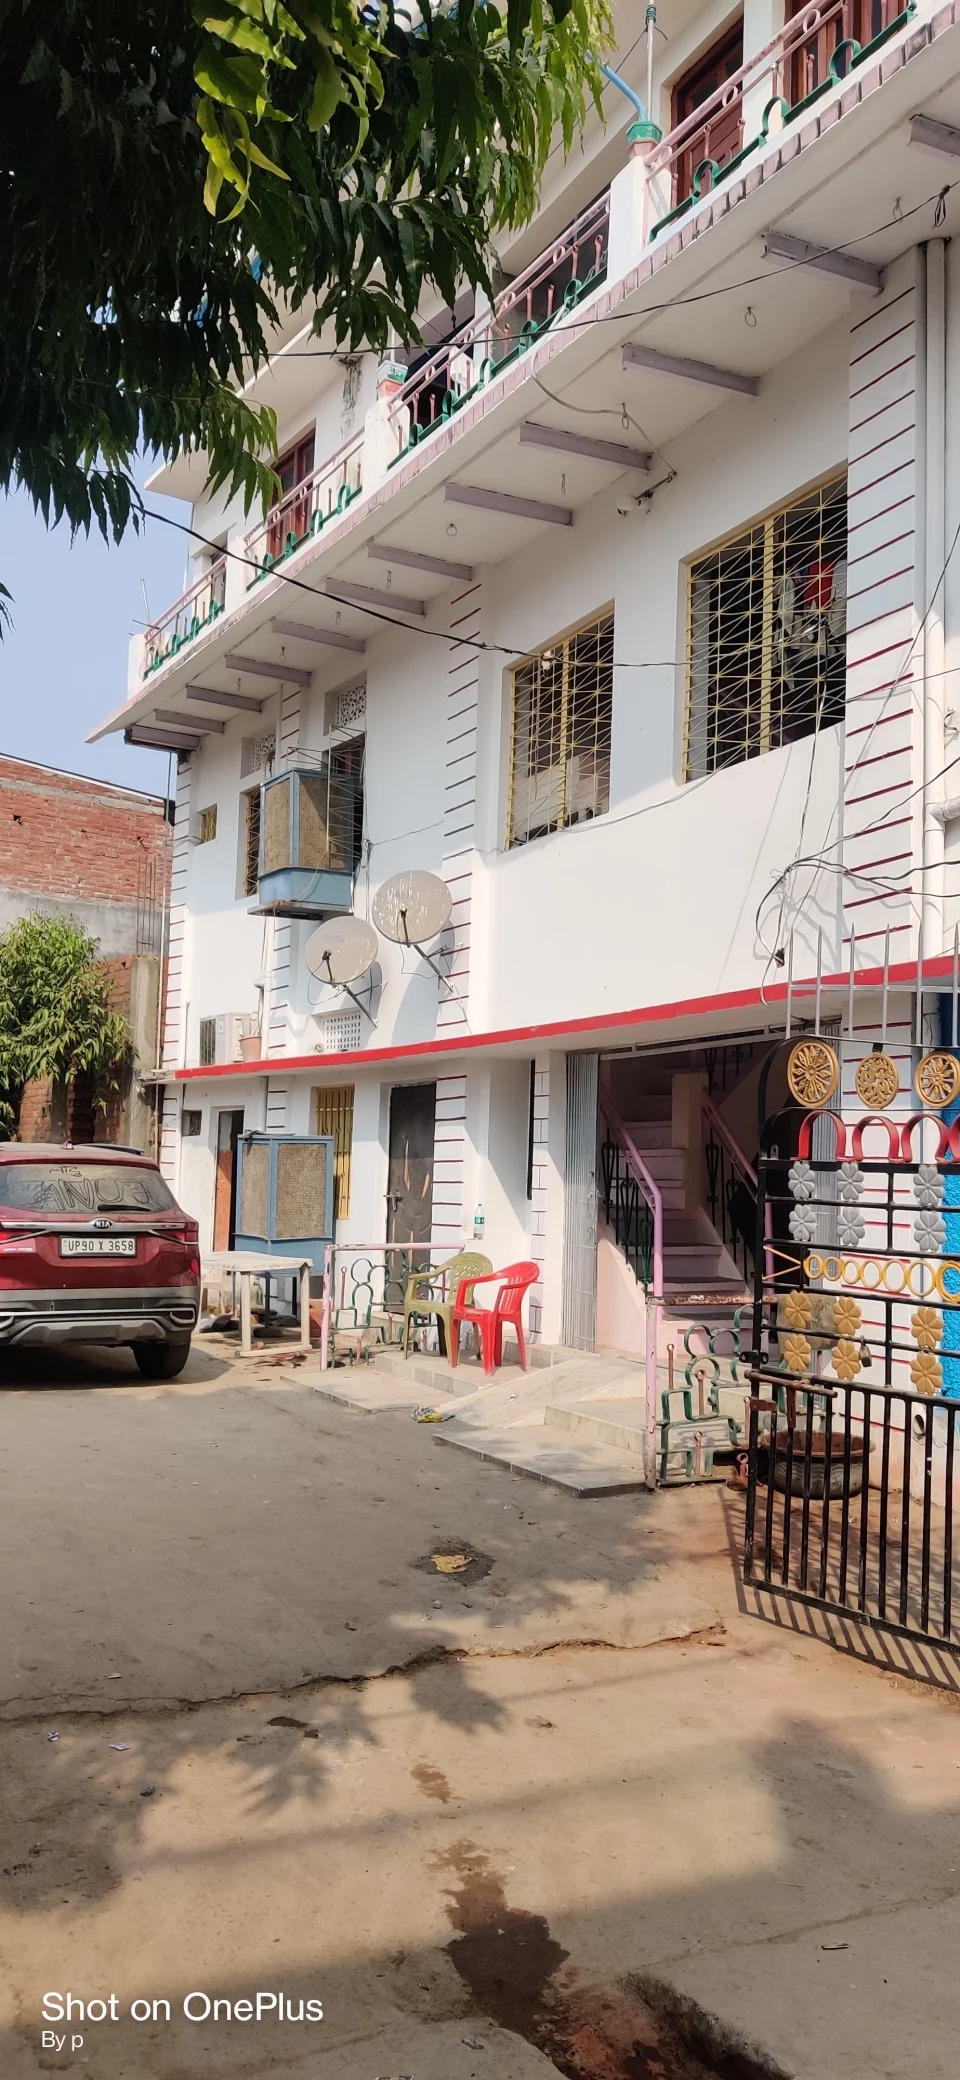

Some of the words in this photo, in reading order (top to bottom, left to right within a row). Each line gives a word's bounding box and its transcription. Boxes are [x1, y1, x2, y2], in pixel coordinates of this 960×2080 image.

[94, 1220, 112, 1229] KIA
[68, 1240, 95, 1251] UP90
[98, 1240, 104, 1251] X
[108, 1240, 135, 1251] 3658
